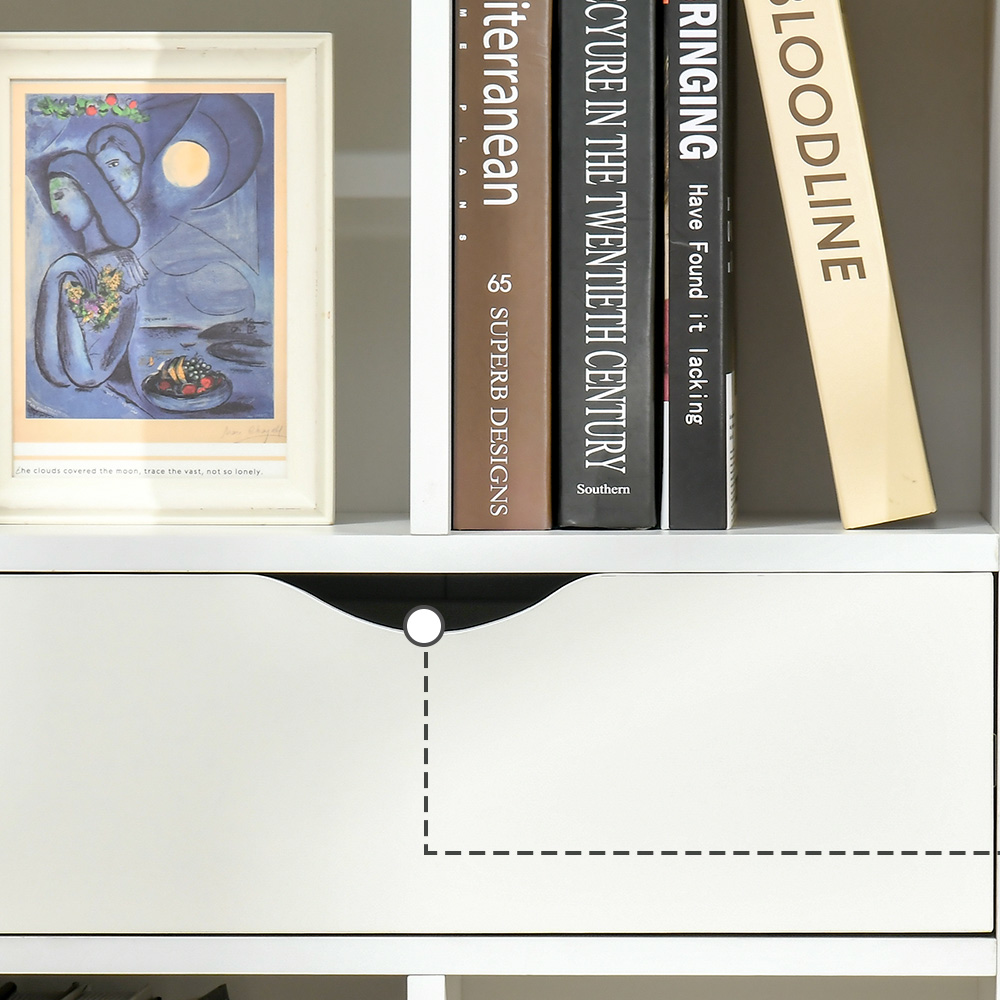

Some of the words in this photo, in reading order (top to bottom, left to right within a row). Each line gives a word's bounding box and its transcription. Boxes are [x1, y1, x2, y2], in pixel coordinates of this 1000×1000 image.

[584, 0, 628, 93] CYURE
[585, 99, 628, 128] IN
[585, 133, 628, 185] THE
[688, 184, 709, 230] Have
[487, 274, 512, 293] 65
[585, 191, 628, 344] TWENTIETH
[688, 242, 709, 299] Found
[688, 312, 709, 333] it
[489, 307, 509, 400] SUPERB
[584, 350, 628, 474] CENTURY
[685, 348, 709, 425] lacking
[33, 466, 61, 475] clouds
[63, 466, 97, 475] covered
[100, 466, 113, 475] the
[116, 467, 142, 476] moon,
[144, 467, 166, 476] trace
[168, 467, 182, 476] the
[184, 467, 205, 477] vast,
[206, 468, 221, 476] not
[223, 468, 233, 476] so
[235, 467, 264, 477] lonely.
[489, 407, 509, 516] DESIGNS
[576, 482, 631, 497] Southern
